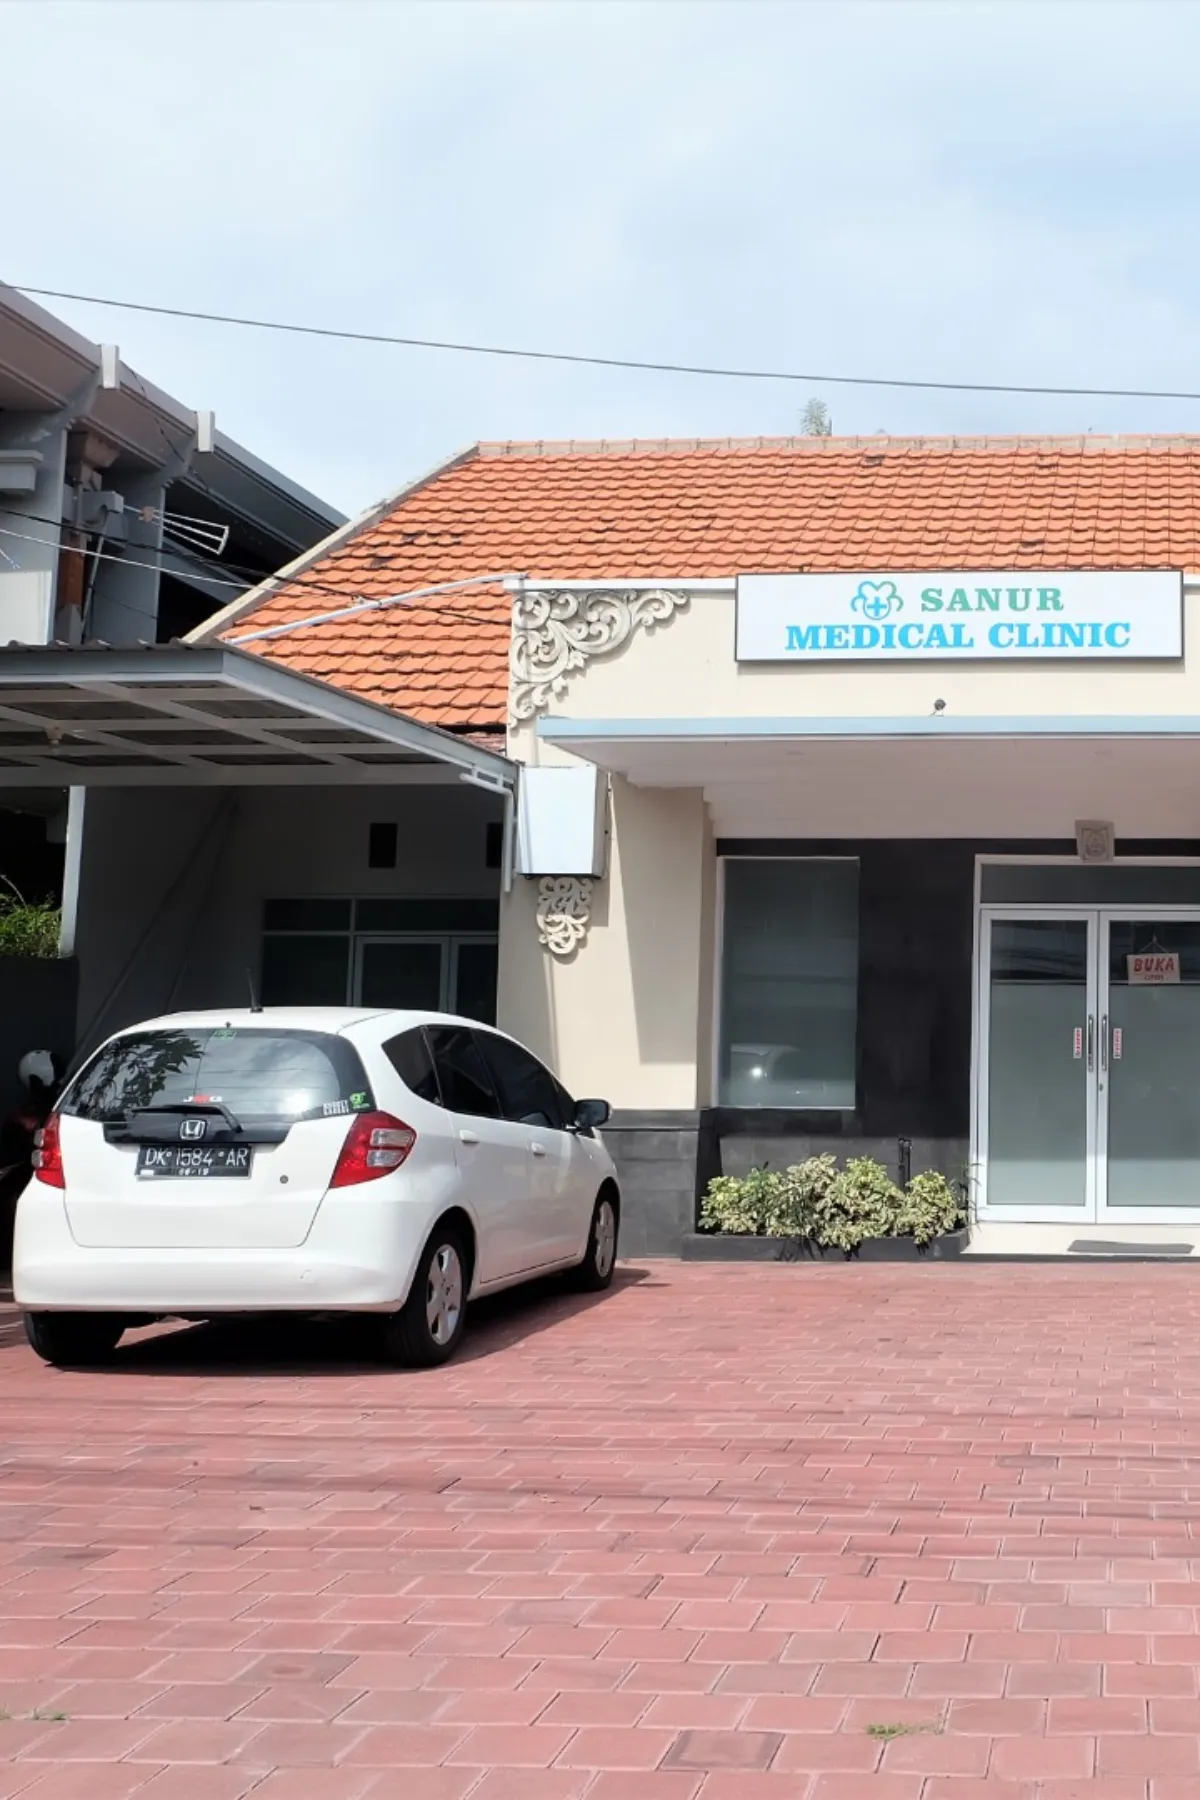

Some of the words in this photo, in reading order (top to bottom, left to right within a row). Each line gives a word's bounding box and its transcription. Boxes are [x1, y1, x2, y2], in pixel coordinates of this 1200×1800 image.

[920, 587, 1065, 612] SANUR
[785, 623, 975, 651] MEDICAL
[987, 622, 1131, 648] CLINIC
[1133, 957, 1174, 972] BUKA
[144, 1148, 166, 1166] DK
[175, 1149, 214, 1167] 1584
[225, 1149, 249, 1166] AR
